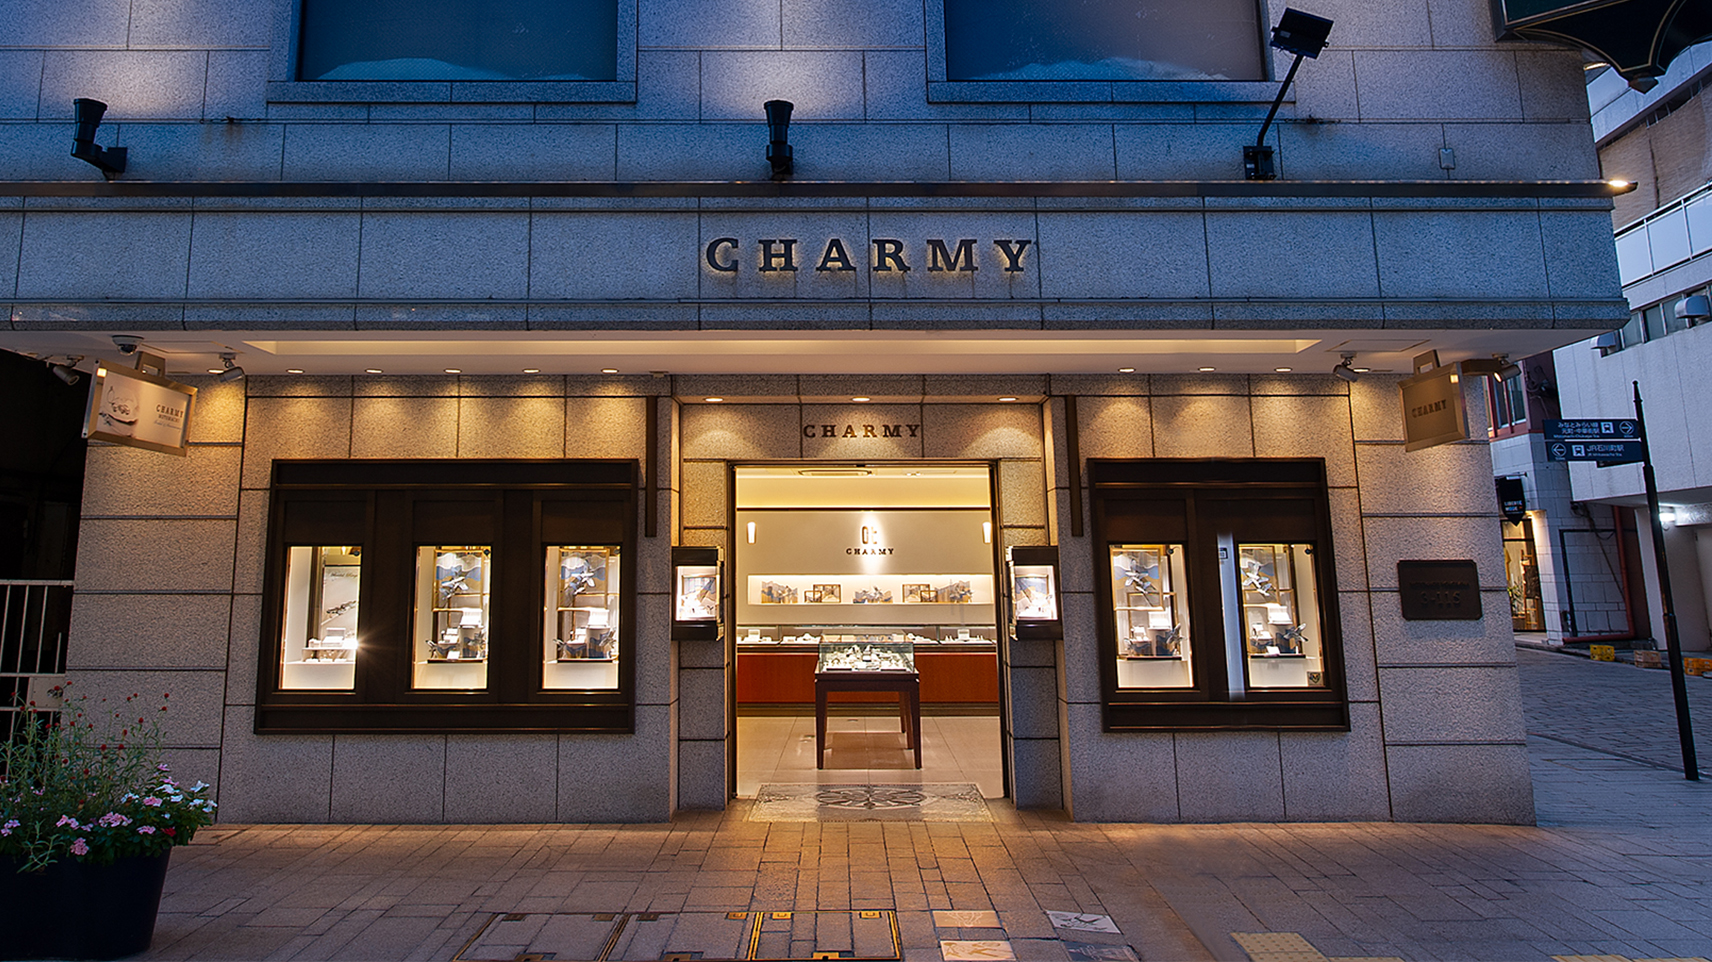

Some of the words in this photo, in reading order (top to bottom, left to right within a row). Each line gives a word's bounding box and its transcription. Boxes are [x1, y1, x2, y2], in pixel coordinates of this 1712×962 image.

[706, 237, 1032, 273] CHARMY
[156, 404, 183, 418] CHARMY
[1411, 399, 1447, 418] CHARMY
[803, 424, 921, 438] CHARMY
